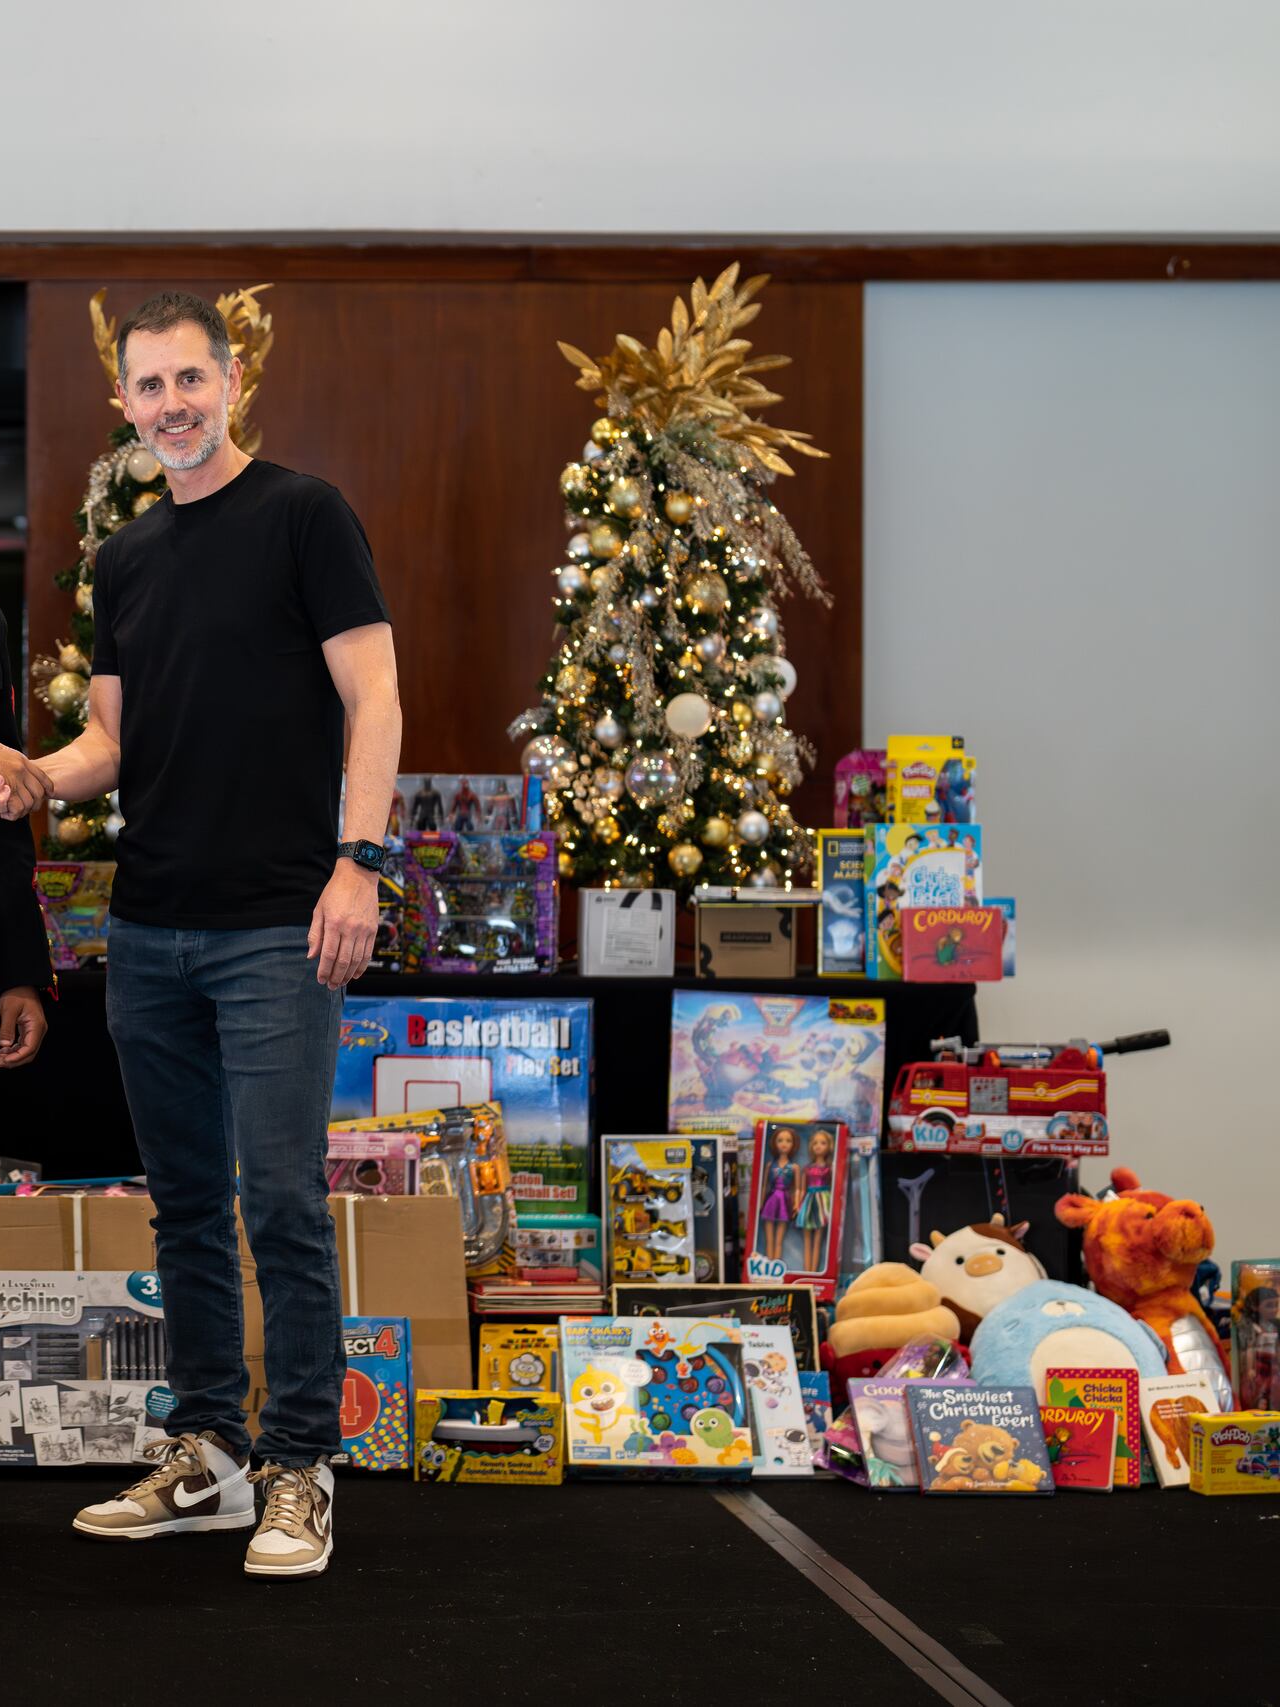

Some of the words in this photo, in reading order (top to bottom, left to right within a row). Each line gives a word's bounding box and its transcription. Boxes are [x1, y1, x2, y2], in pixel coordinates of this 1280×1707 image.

[913, 909, 993, 933] CORDUROY
[407, 1014, 571, 1049] Basketball
[506, 1056, 545, 1077] Play
[549, 1055, 580, 1076] Set
[915, 1127, 947, 1142] KID
[749, 1259, 785, 1277] KID
[920, 1388, 942, 1400] The
[942, 1389, 1015, 1405] Snowiest
[1083, 1383, 1123, 1393] Chicka
[1083, 1393, 1123, 1403] Chicka
[929, 1402, 1023, 1421] Christmas
[991, 1414, 1035, 1427] Ever!
[1039, 1409, 1105, 1435] ORDUROY
[1211, 1428, 1252, 1445] Play-Doh
